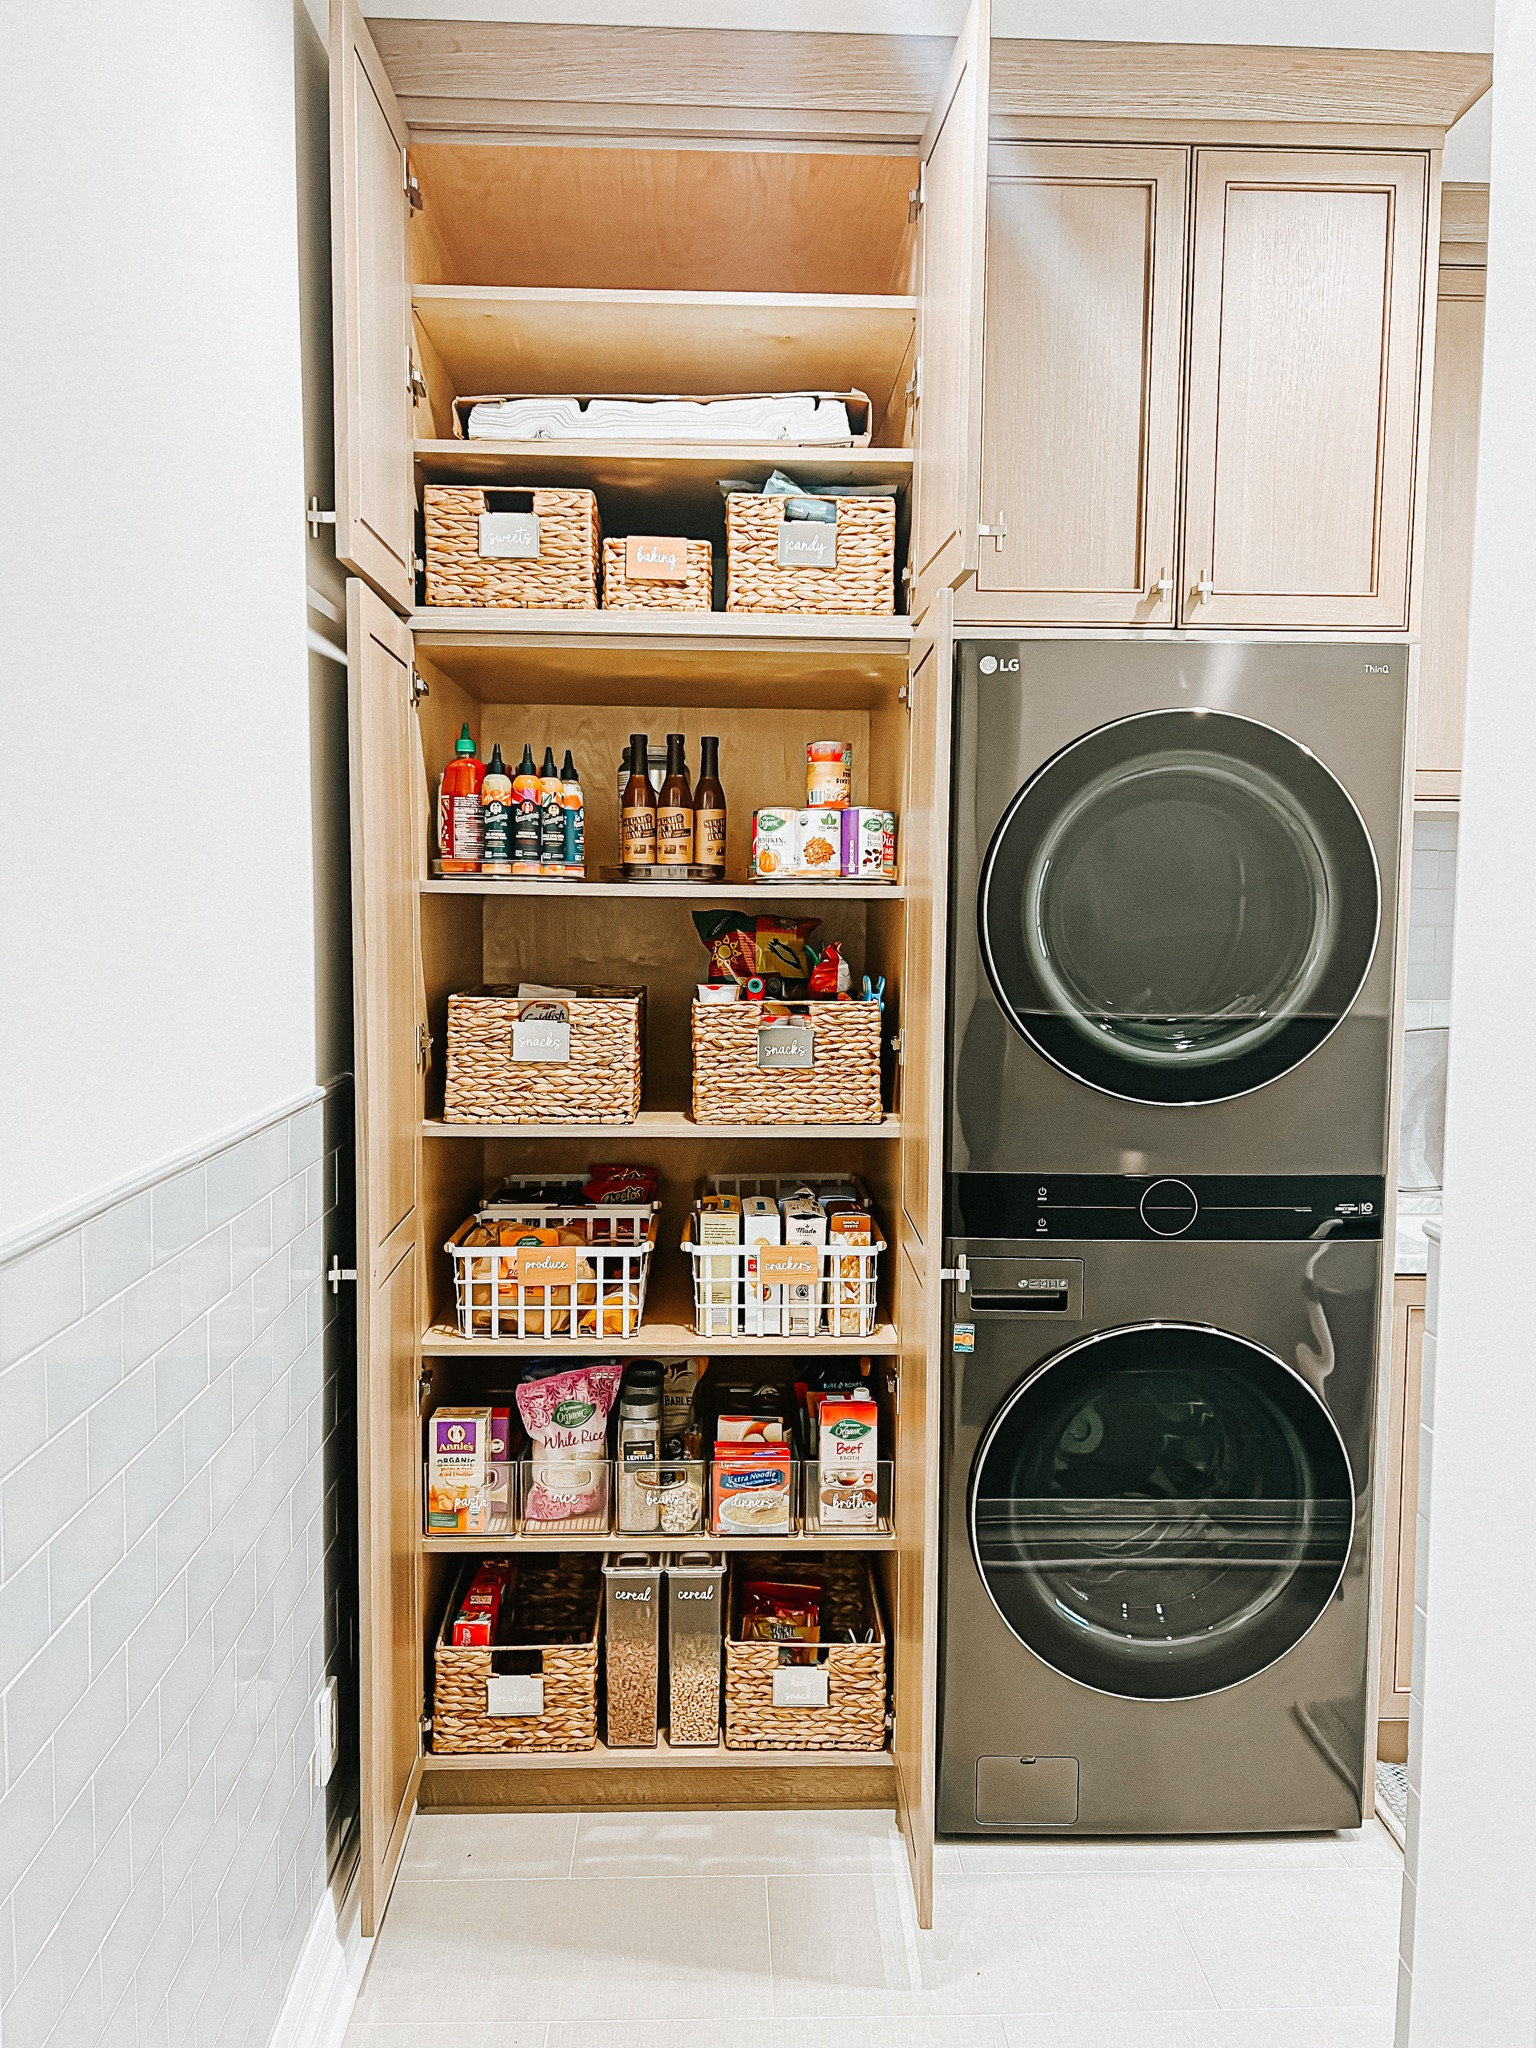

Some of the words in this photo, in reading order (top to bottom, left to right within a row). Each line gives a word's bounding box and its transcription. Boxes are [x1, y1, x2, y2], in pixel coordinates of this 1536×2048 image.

[488, 527, 534, 546] sweets
[788, 534, 827, 560] candy
[636, 546, 679, 571] baking
[1000, 658, 1020, 672] LG
[1363, 664, 1390, 674] ThinQ
[704, 819, 724, 828] SUGA
[519, 1032, 563, 1050] snacks
[764, 1039, 807, 1056] snacks
[525, 1255, 568, 1275] produce
[765, 1256, 812, 1271] crackers
[664, 1395, 692, 1405] BARLE
[557, 1408, 587, 1424] Organic
[544, 1431, 579, 1449] White
[581, 1429, 604, 1445] Rice
[835, 1426, 863, 1438] Organic
[439, 1442, 475, 1452] Annie's
[836, 1442, 863, 1455] Beef
[454, 1492, 490, 1513] pasta
[553, 1492, 580, 1504] rice
[646, 1490, 680, 1506] beans
[731, 1493, 777, 1509] dinners
[615, 1586, 652, 1602] cereal
[677, 1584, 714, 1600] cereal
